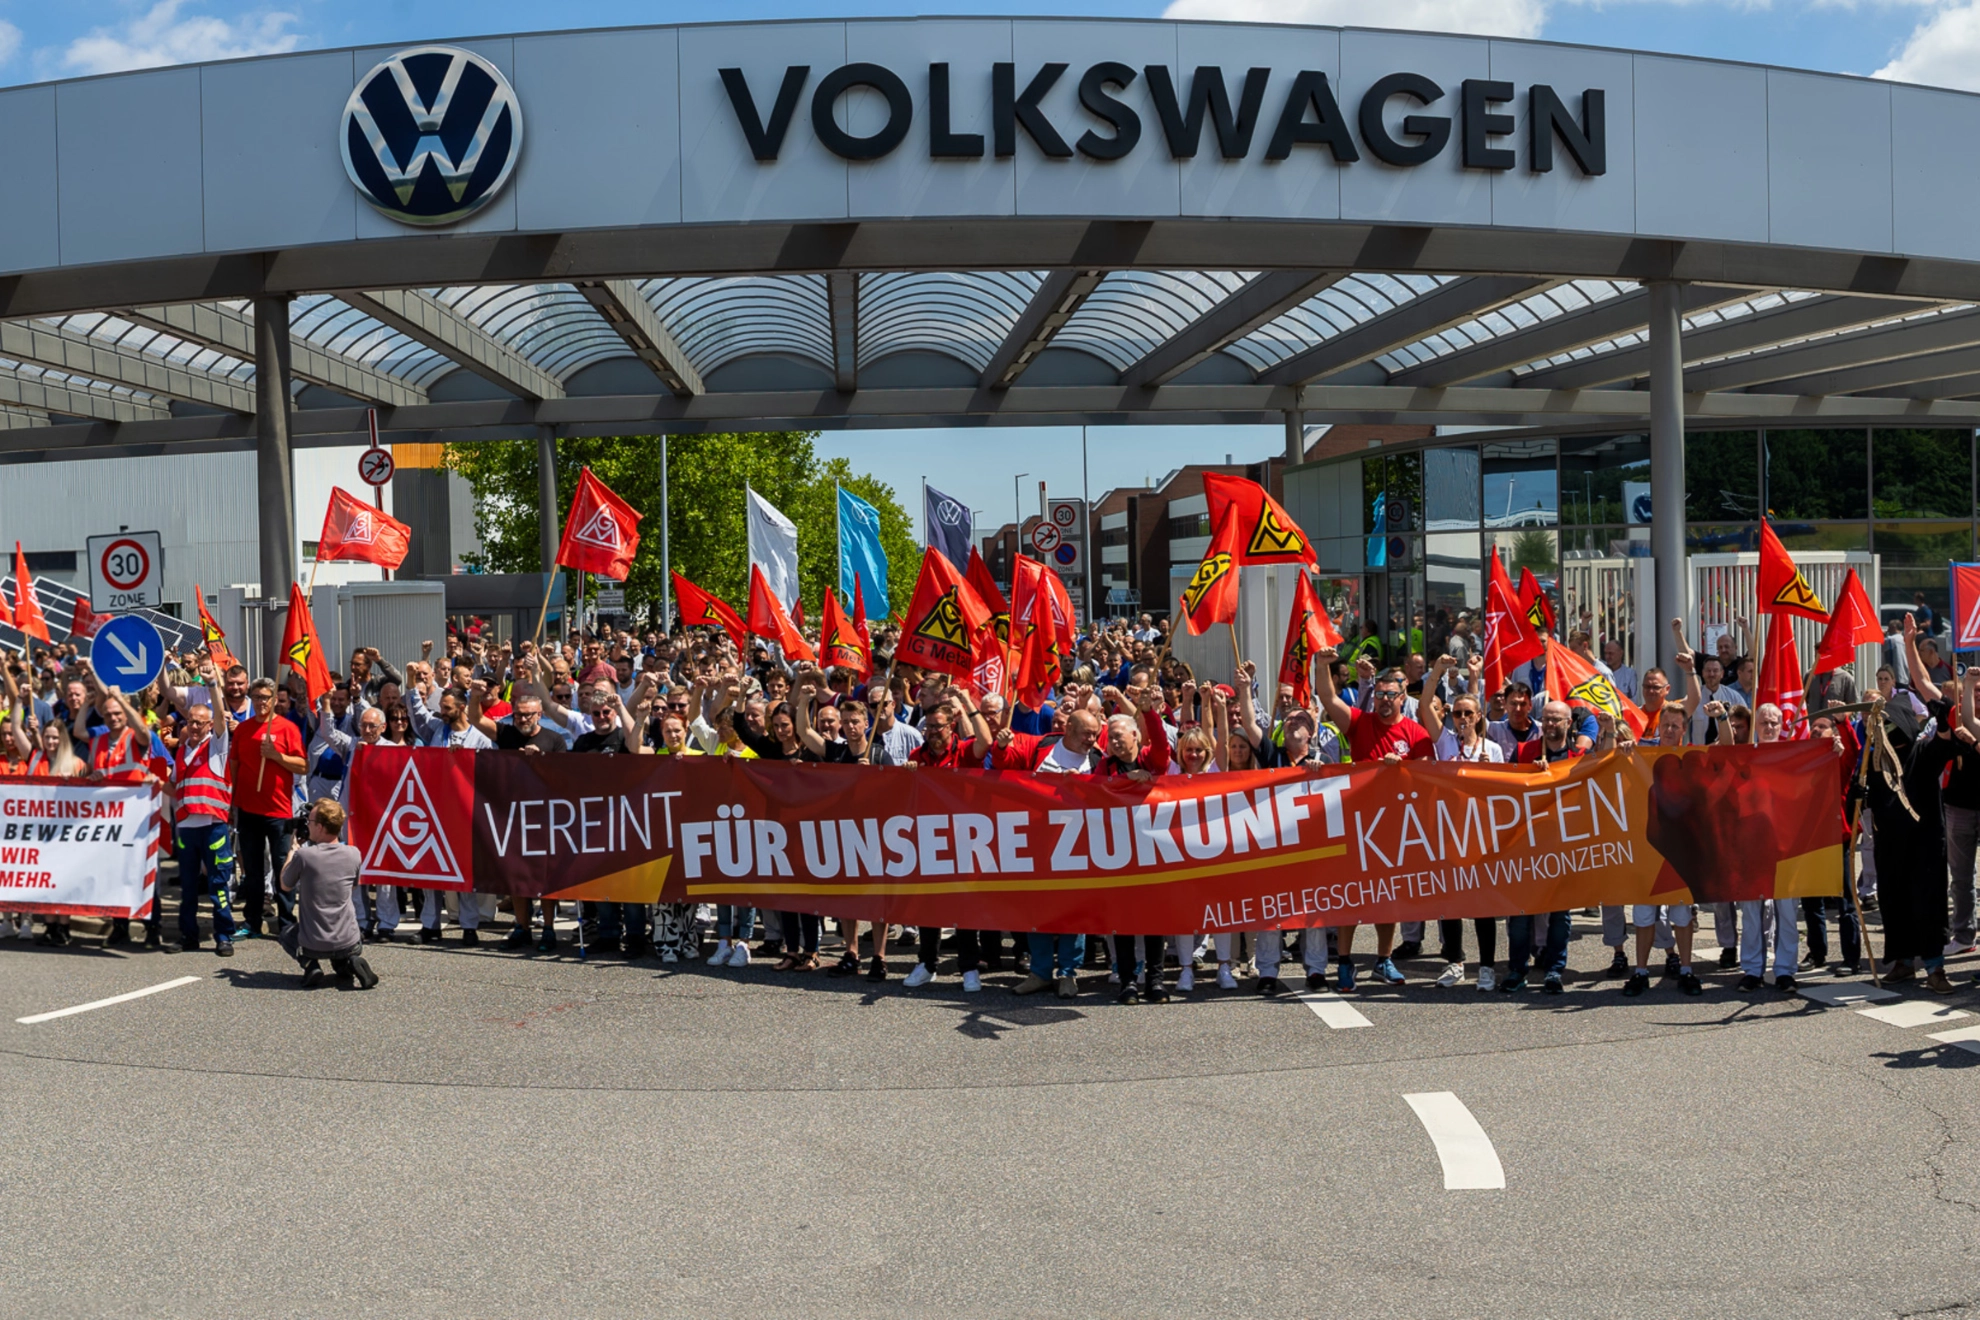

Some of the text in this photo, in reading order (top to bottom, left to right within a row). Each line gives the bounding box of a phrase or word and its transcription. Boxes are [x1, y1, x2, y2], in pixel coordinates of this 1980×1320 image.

[718, 62, 1606, 176] VOLKSWAGEN
[1058, 510, 1072, 521] 30
[111, 552, 139, 577] 30
[109, 592, 146, 607] ZONE
[906, 636, 972, 672] IG Metall
[3, 798, 125, 819] GEMEINSAM
[484, 772, 1630, 879] VEREINT FÜR UNSERE ZUKUNFT KÄMPFEN
[1, 847, 40, 865] WIR
[0, 870, 57, 889] MEHR.
[1202, 840, 1634, 930] ALLE BELEGSCHAFTEN IM VW-KONZERN
